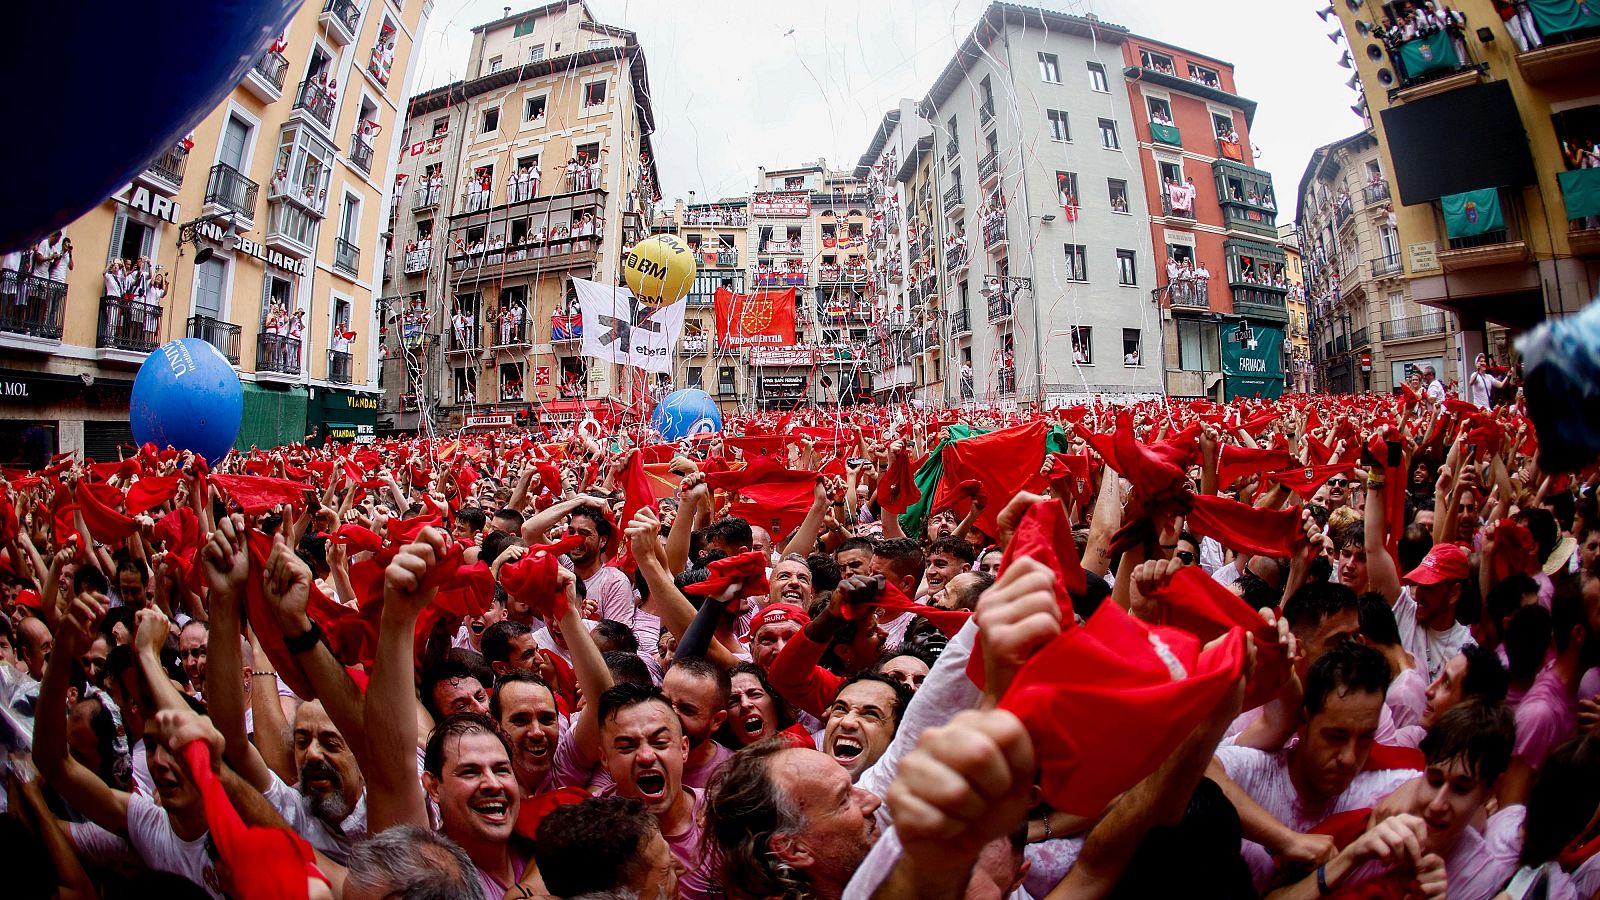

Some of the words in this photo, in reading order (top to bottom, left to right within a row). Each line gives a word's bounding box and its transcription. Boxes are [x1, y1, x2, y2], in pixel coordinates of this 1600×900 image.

[637, 258, 669, 281] BM
[1239, 357, 1266, 372] FARMACIA
[5, 382, 29, 396] MOL
[347, 396, 377, 409] VIANDAS
[332, 430, 356, 438] VIANDAS
